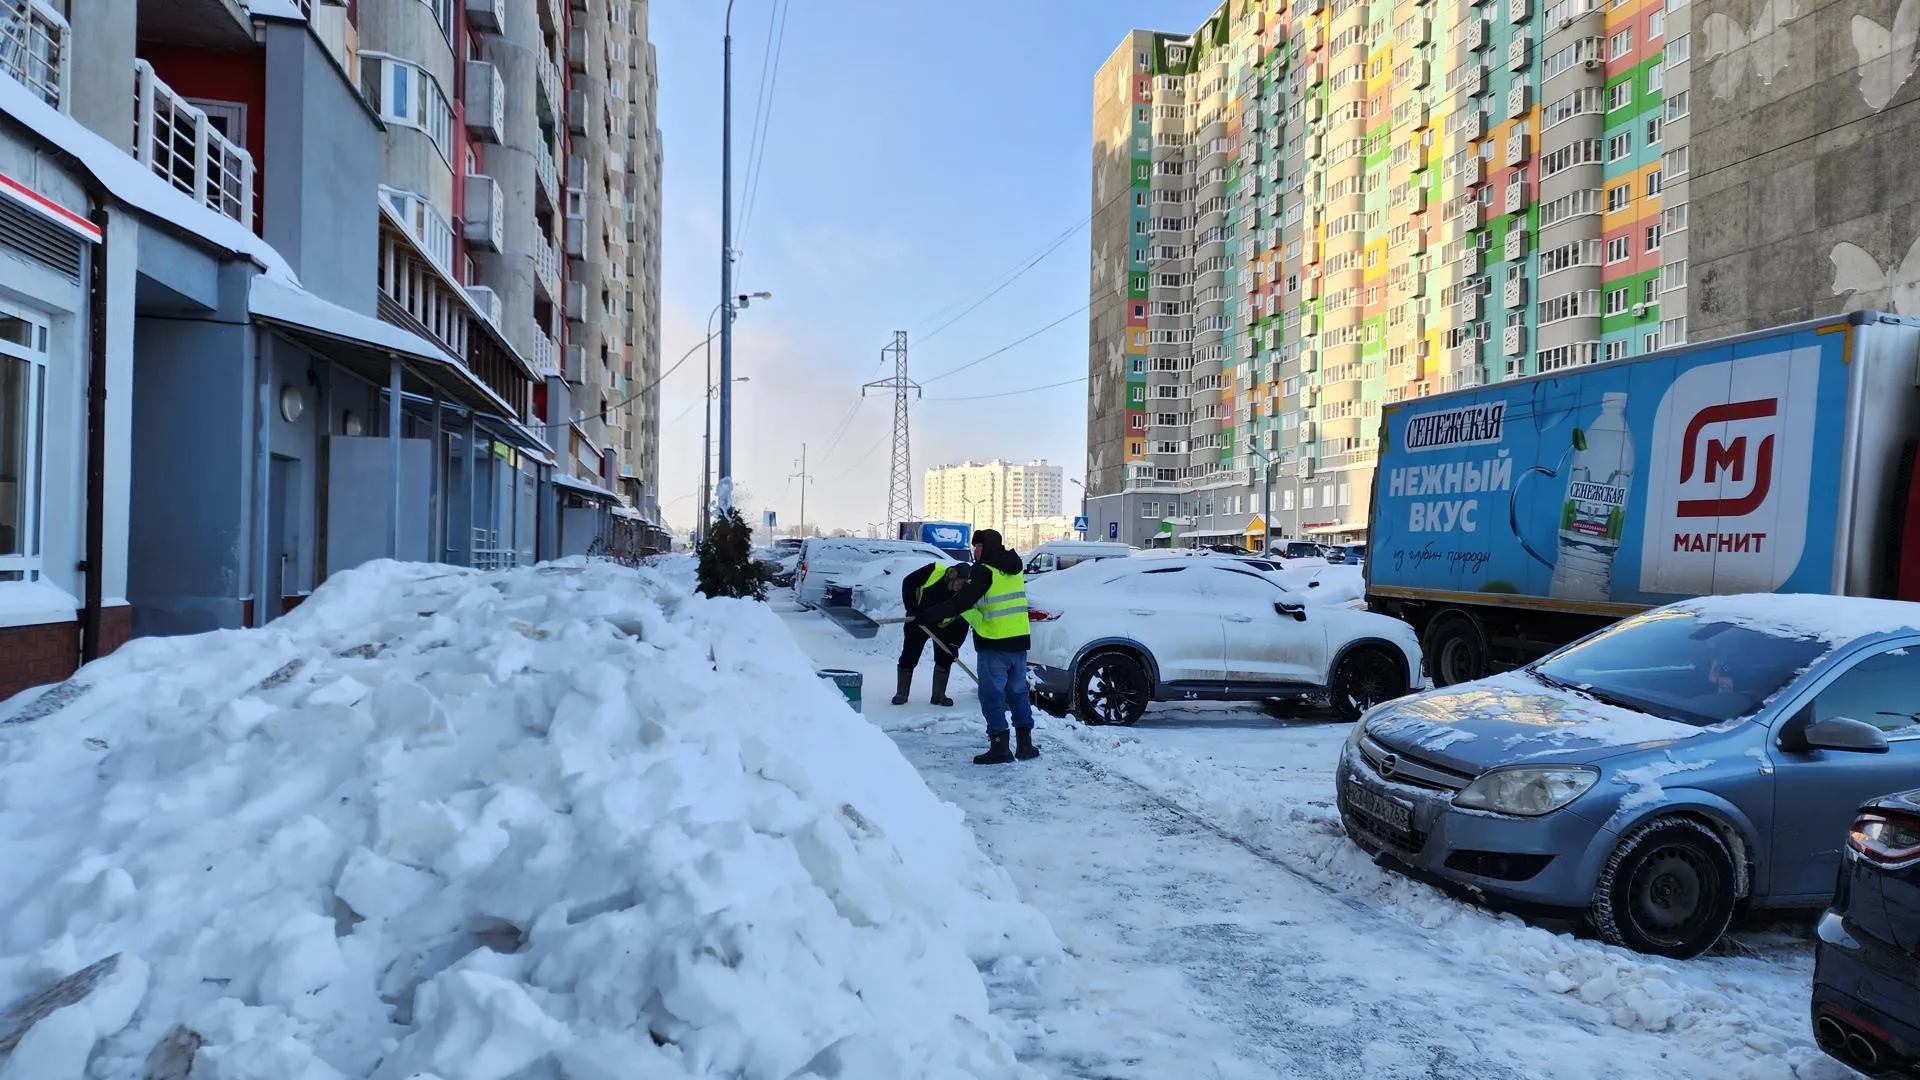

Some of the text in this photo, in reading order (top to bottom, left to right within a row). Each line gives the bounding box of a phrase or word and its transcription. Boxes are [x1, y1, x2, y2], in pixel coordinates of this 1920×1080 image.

[1407, 405, 1504, 448] СЕНЕЖСКАЯ
[1389, 448, 1513, 497] НЕЖНЫЙ
[1704, 436, 1747, 483] М
[1570, 482, 1625, 504] СЕНЕЖСКАЯ
[1409, 500, 1478, 533] ВКУС
[1394, 541, 1491, 574] из глубин природы
[1673, 533, 1767, 552] МАГНИТ
